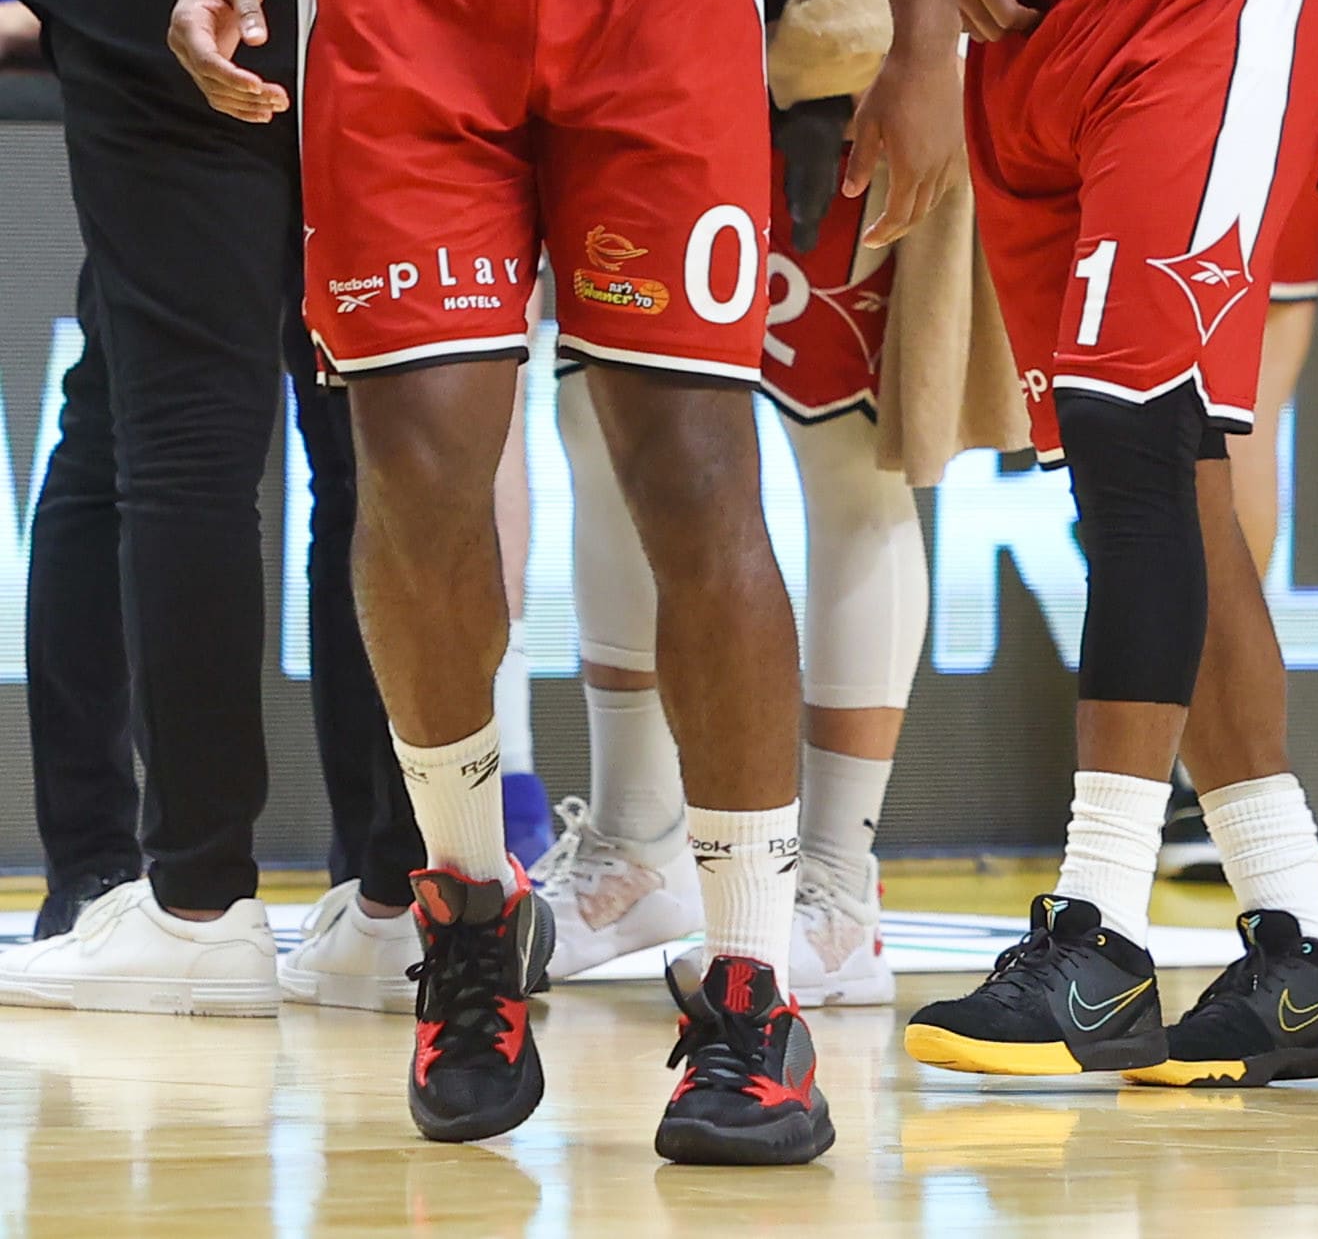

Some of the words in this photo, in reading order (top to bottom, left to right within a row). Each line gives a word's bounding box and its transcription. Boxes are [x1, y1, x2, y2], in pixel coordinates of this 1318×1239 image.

[329, 275, 385, 294] Reebok
[684, 205, 758, 324] 0
[1074, 240, 1118, 347] 1
[444, 295, 502, 310] HOTELS
